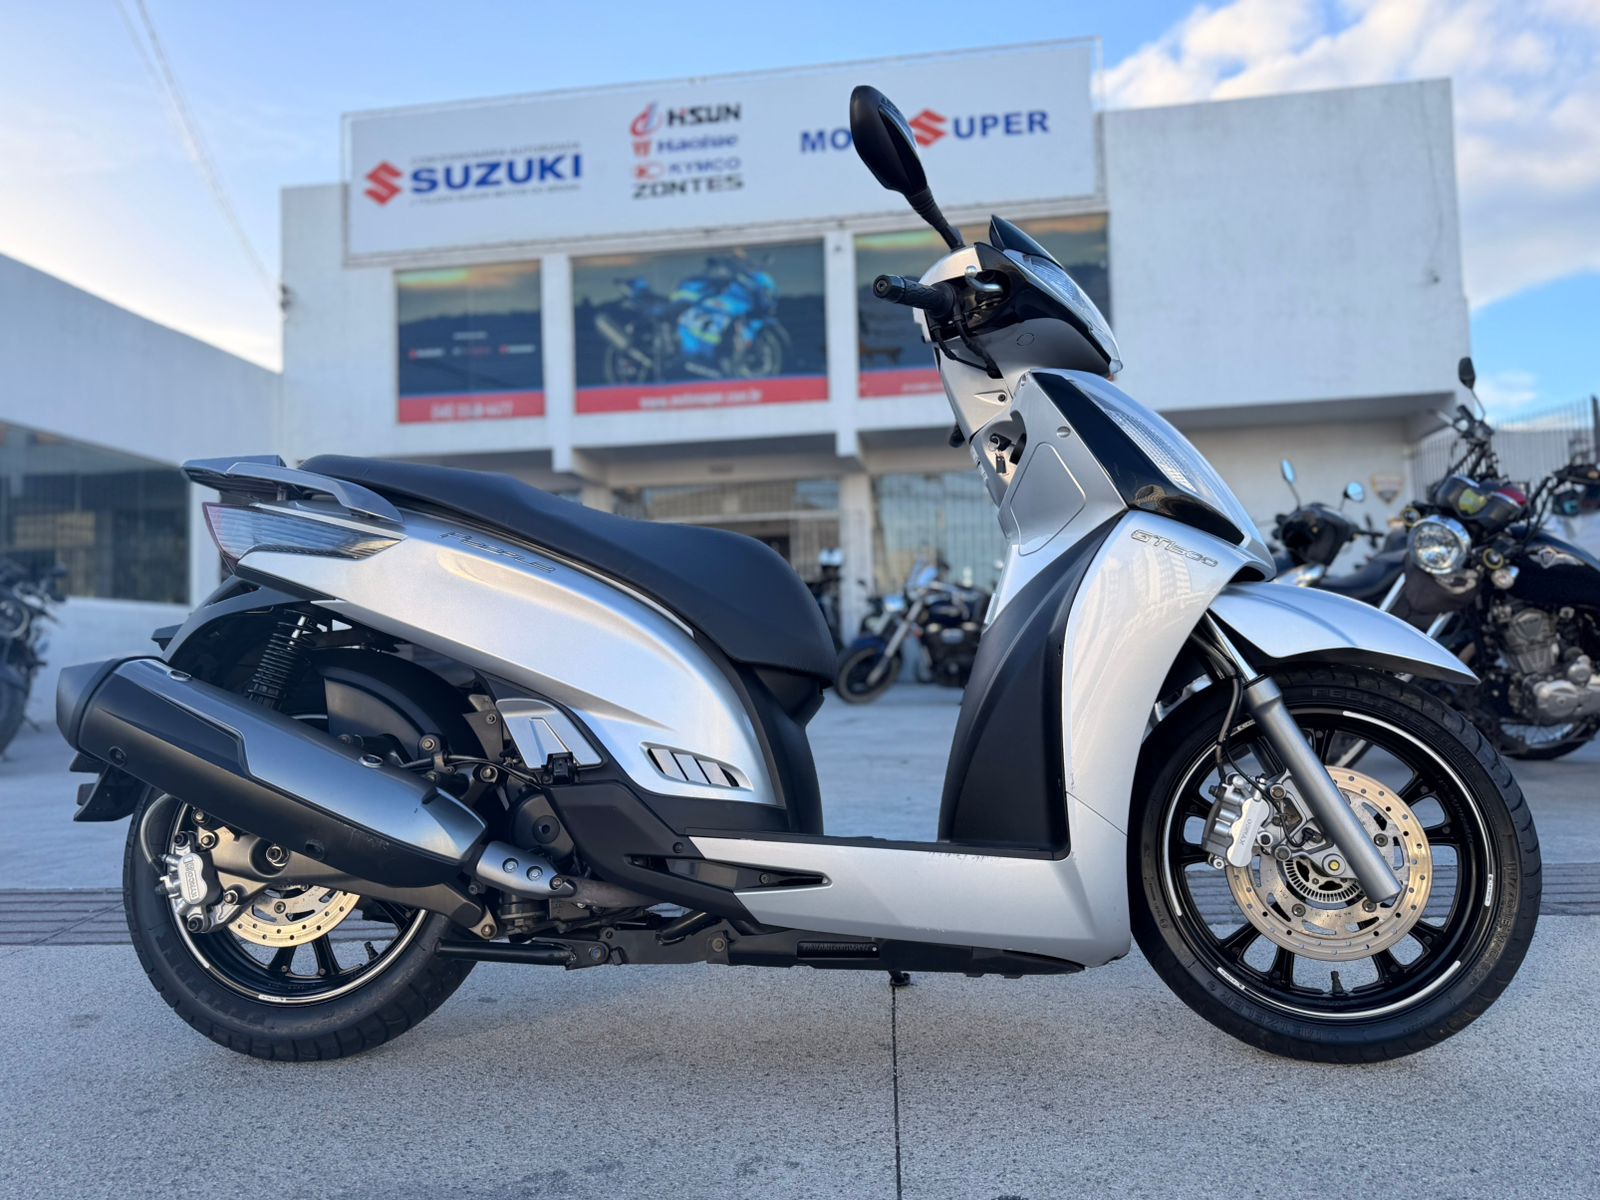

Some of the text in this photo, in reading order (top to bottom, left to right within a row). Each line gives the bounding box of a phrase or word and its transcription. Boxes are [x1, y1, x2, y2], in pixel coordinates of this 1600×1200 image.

[667, 102, 742, 127] HSUN
[410, 153, 582, 194] SUZUKI
[631, 173, 744, 200] ZONTES
